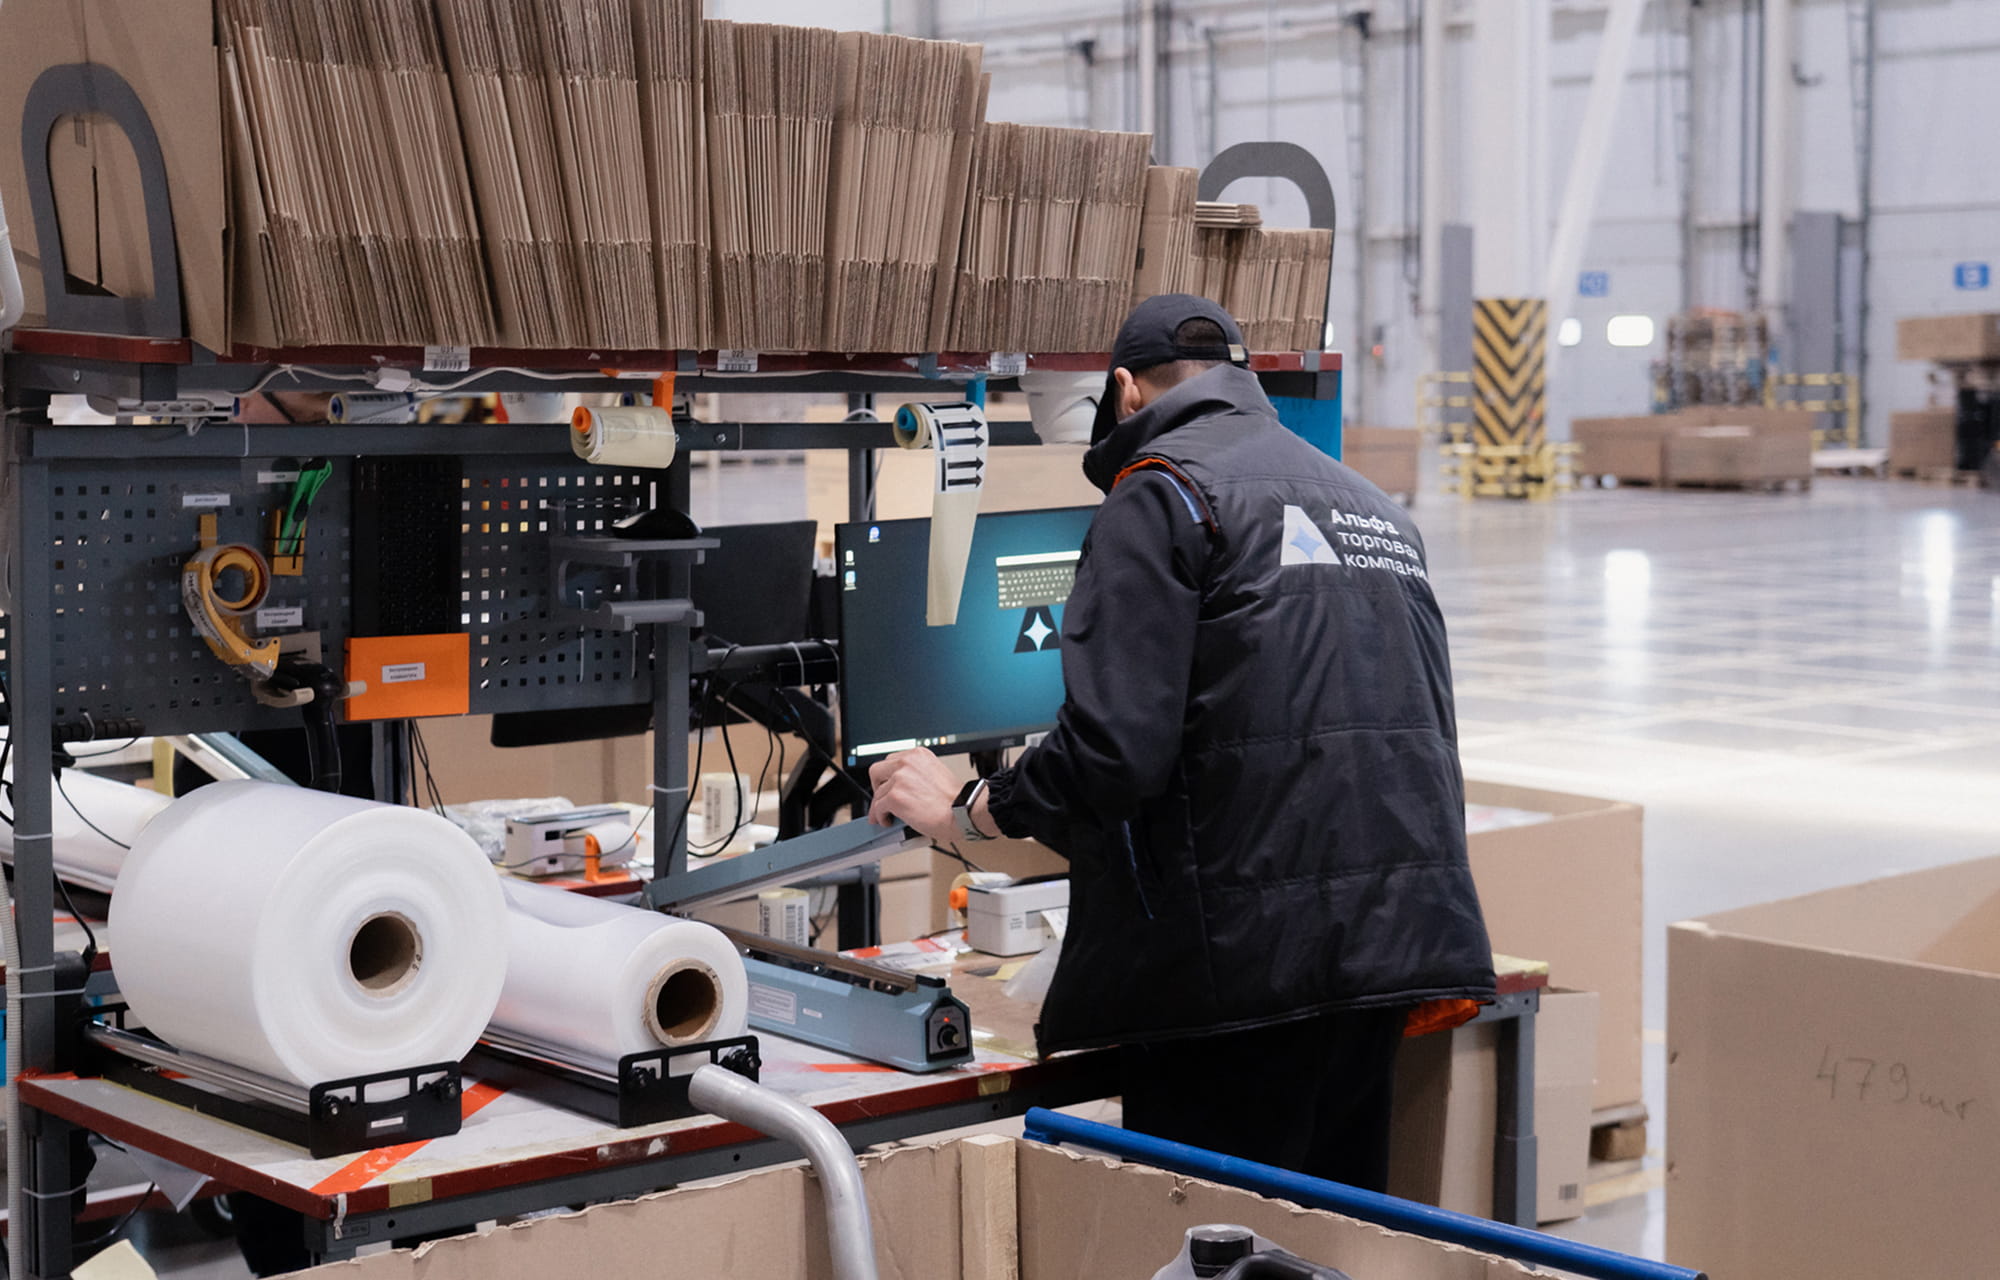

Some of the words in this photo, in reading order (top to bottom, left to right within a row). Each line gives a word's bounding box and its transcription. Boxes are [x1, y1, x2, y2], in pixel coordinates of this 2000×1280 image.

[1331, 508, 1400, 535] Альфа
[1344, 553, 1428, 582] компани
[1815, 1045, 1911, 1104] 479
